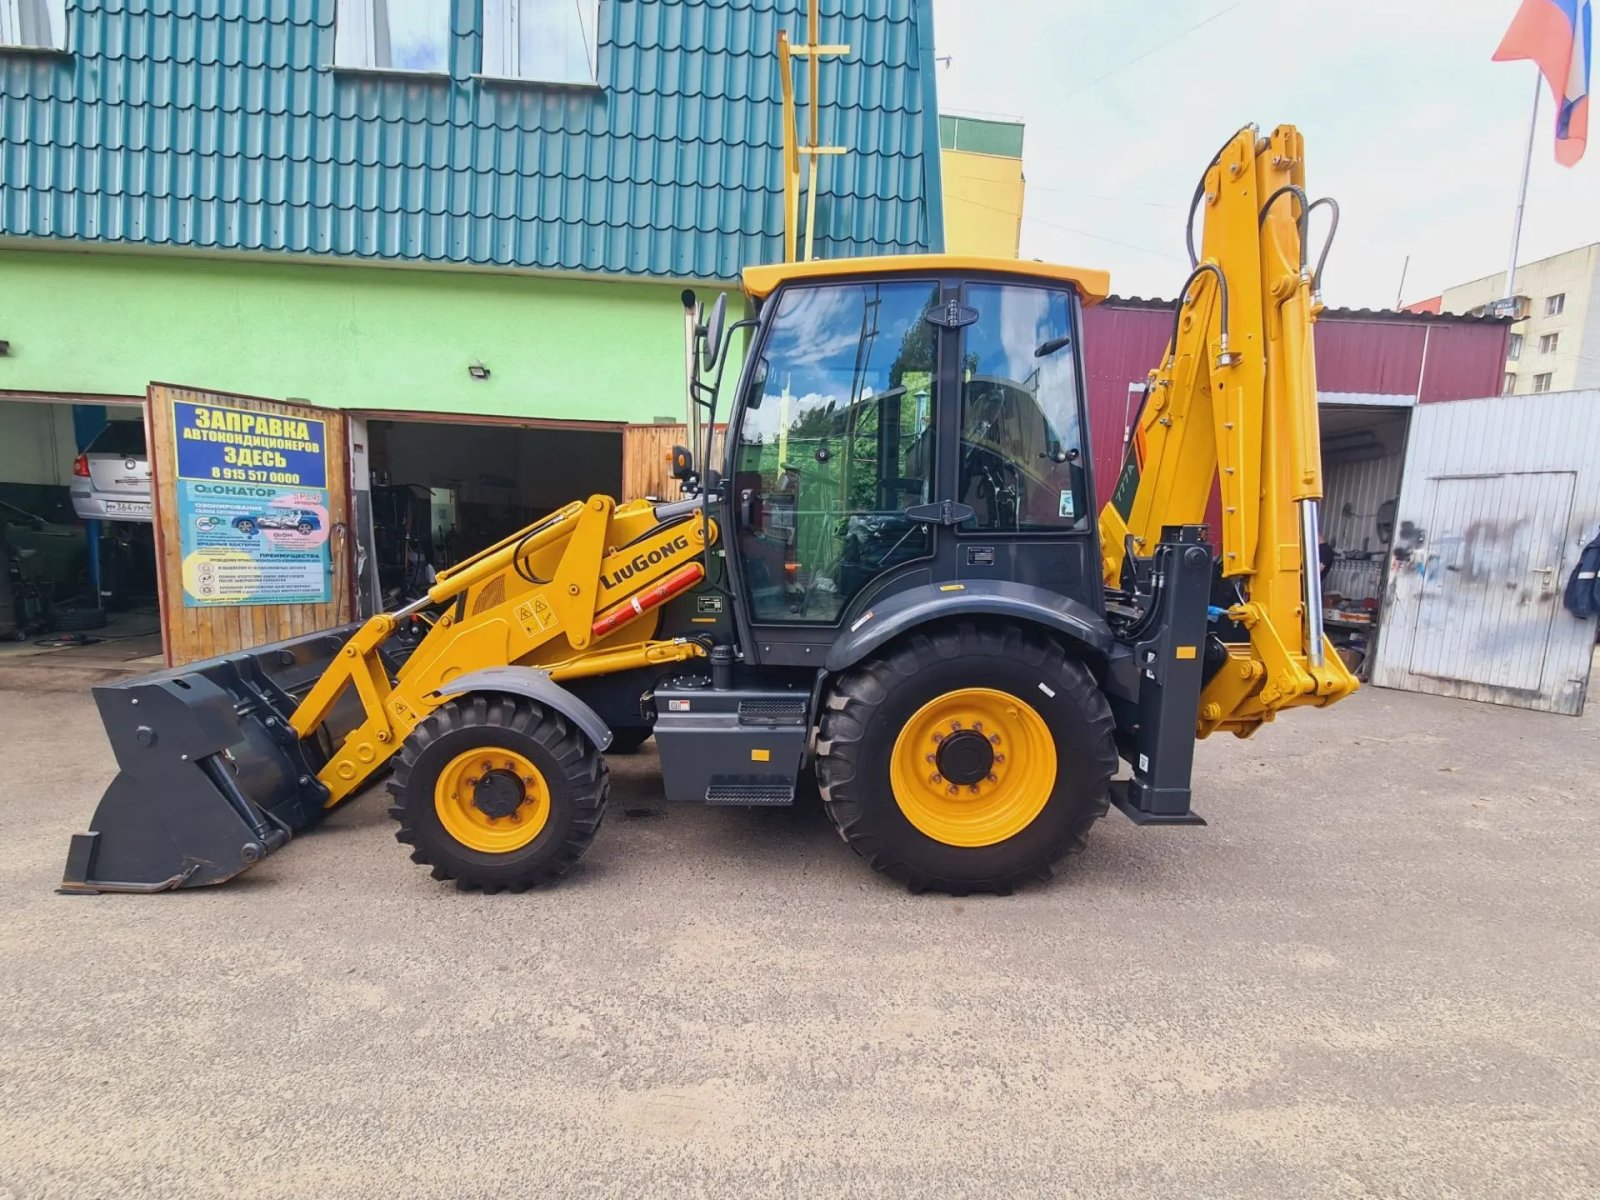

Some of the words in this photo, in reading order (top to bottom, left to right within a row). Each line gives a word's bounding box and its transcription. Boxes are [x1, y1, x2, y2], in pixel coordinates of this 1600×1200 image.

[194, 407, 310, 440] ЗАПРАВКА
[183, 428, 320, 453] АВТОКОНДИЦИОНЕРОВ
[223, 446, 287, 468] ЗДЕСЬ
[211, 467, 220, 478] 8
[223, 468, 244, 480] 915
[248, 470, 267, 482] 517
[269, 471, 299, 484] 0000
